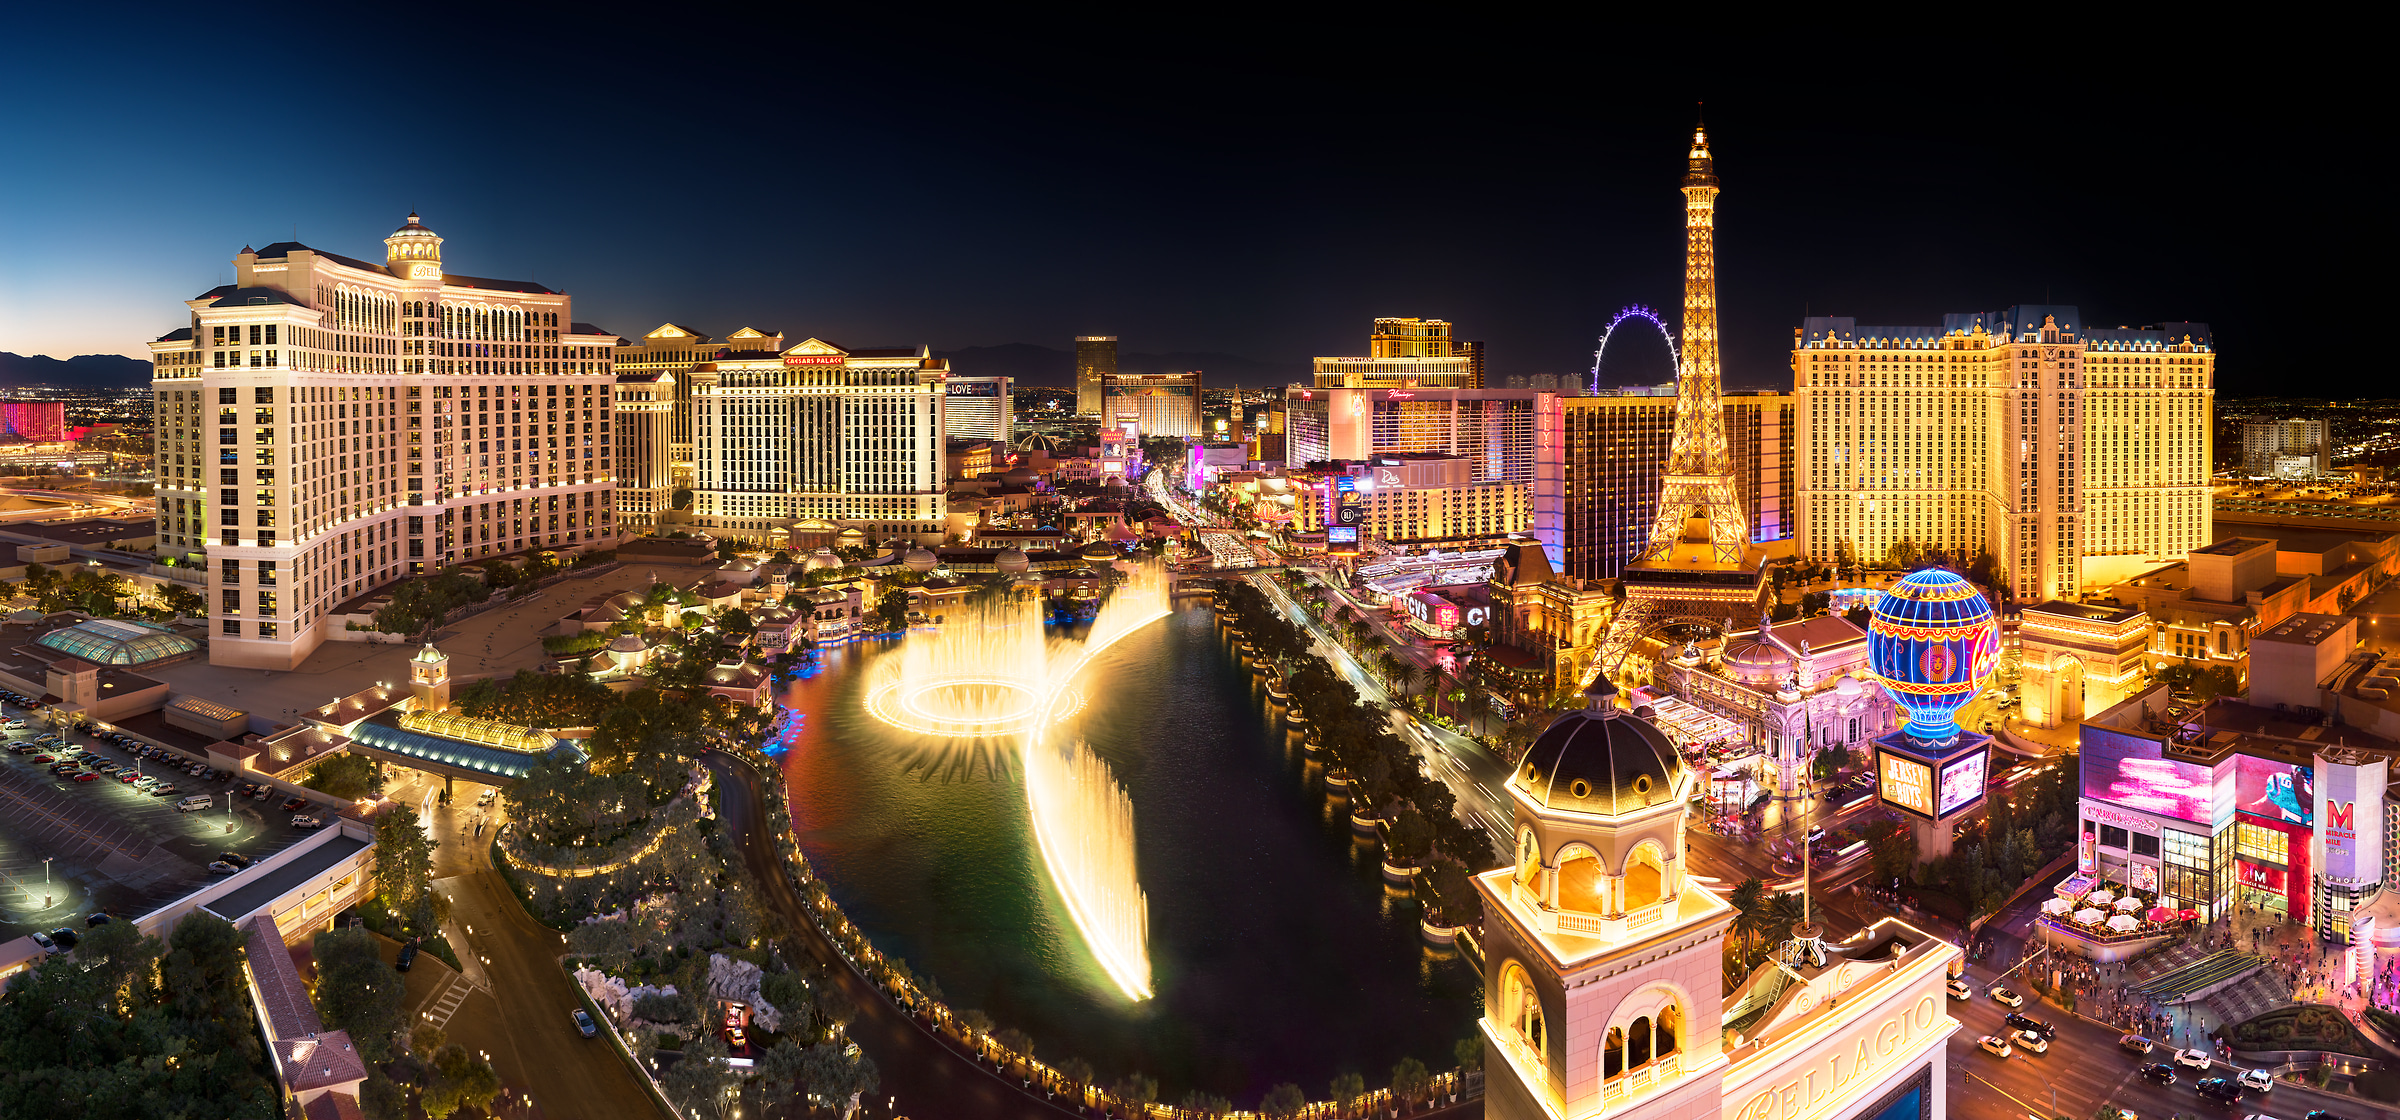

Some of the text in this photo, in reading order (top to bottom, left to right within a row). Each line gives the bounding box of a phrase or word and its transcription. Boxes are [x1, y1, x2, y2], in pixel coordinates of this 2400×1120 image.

[951, 384, 972, 394] LOVE
[1387, 388, 1415, 399] Flamingo
[1408, 596, 1427, 622] CVS
[1887, 758, 1924, 787] JERSEY
[1895, 781, 1923, 808] BOYS
[2326, 829, 2356, 840] MIRACLE
[2326, 838, 2341, 847] MILE
[2326, 846, 2350, 857] SHOPS
[2254, 869, 2266, 884] M
[2319, 870, 2365, 884] SEPHORA
[2238, 878, 2257, 888] MIRACLE
[1735, 996, 1937, 1120] BELLAGIO
